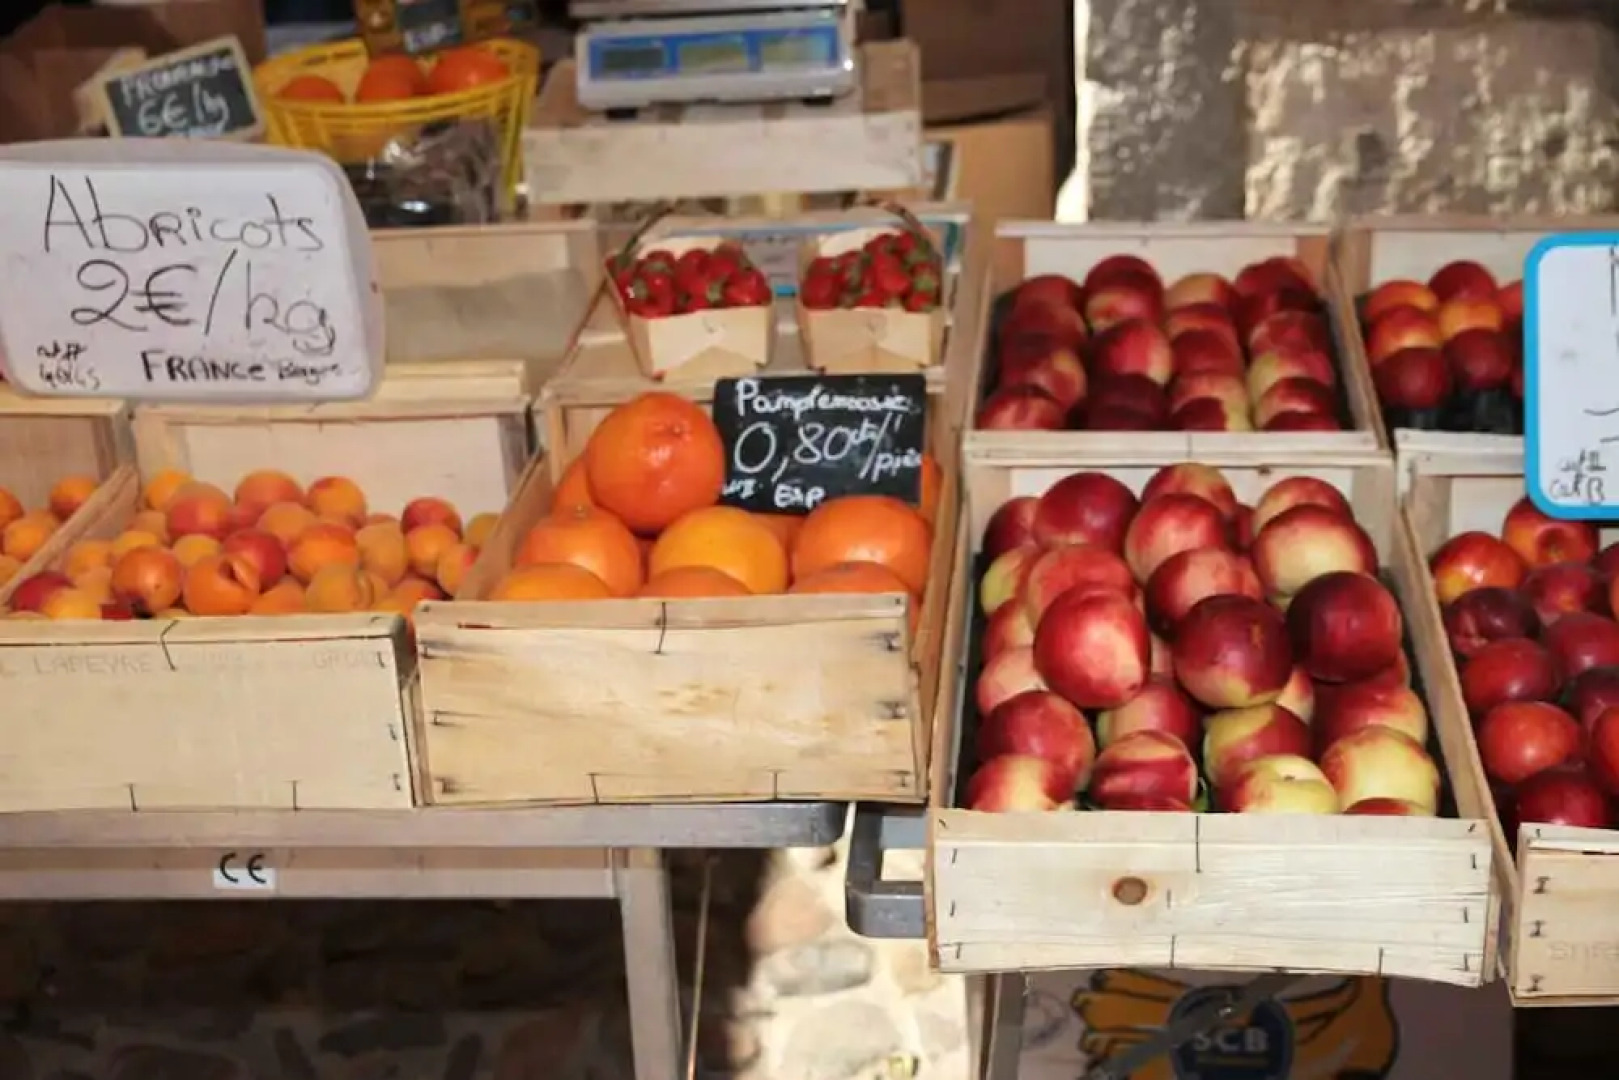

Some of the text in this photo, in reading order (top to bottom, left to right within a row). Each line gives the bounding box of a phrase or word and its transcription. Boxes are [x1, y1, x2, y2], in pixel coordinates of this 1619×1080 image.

[44, 174, 325, 252] Abricots
[71, 248, 337, 355] 2€/kg
[220, 853, 267, 884] CE
[1193, 1028, 1269, 1052] SCB
